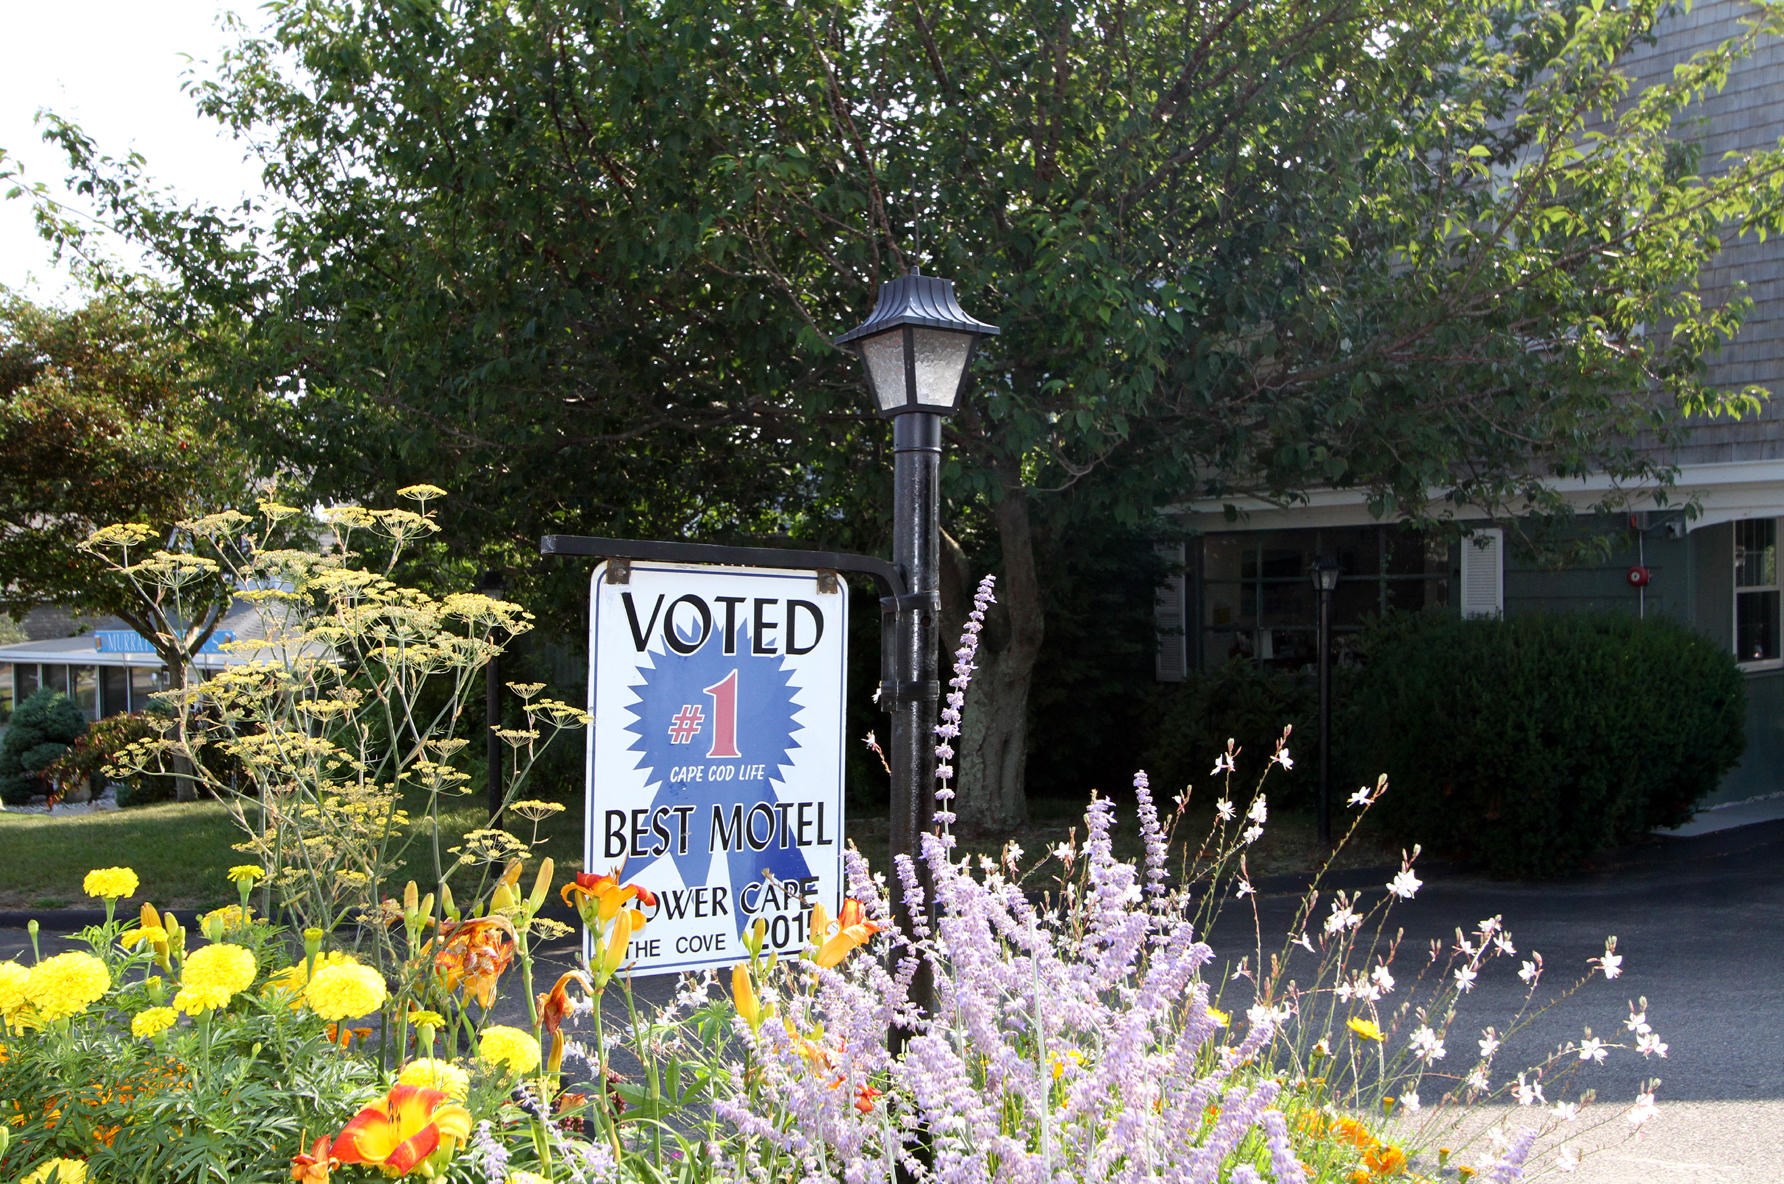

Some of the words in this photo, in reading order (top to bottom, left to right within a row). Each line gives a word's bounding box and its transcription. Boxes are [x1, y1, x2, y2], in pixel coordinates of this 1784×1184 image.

[621, 592, 824, 655] VOTED
[668, 669, 741, 758] #1
[670, 766, 704, 783] CAPE
[708, 765, 734, 782] COD
[739, 764, 766, 780] LIFE
[604, 805, 694, 858] BEST
[710, 801, 833, 851] MOTEL
[621, 886, 728, 923] OWER
[740, 876, 819, 914] CAPE
[676, 933, 726, 954] COVE
